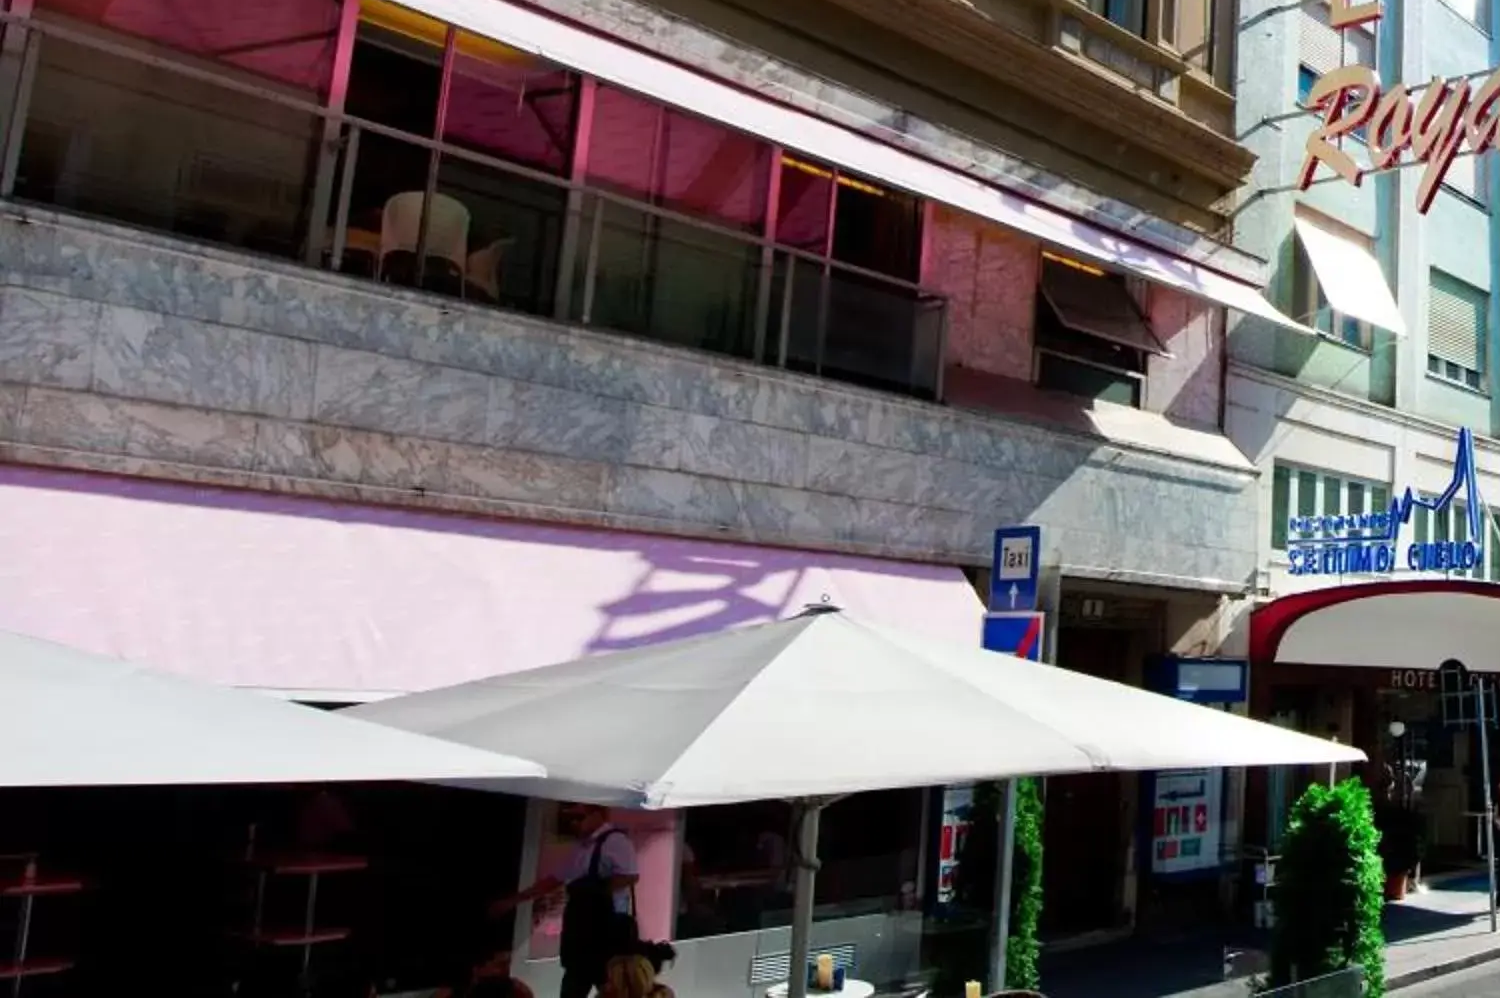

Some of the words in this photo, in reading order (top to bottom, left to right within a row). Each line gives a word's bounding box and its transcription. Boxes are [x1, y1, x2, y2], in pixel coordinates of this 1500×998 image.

[1003, 545, 1029, 568] Taxi
[1288, 543, 1394, 576] SETTIMO
[1408, 540, 1481, 571] CIELO
[1391, 669, 1439, 690] HOTE
